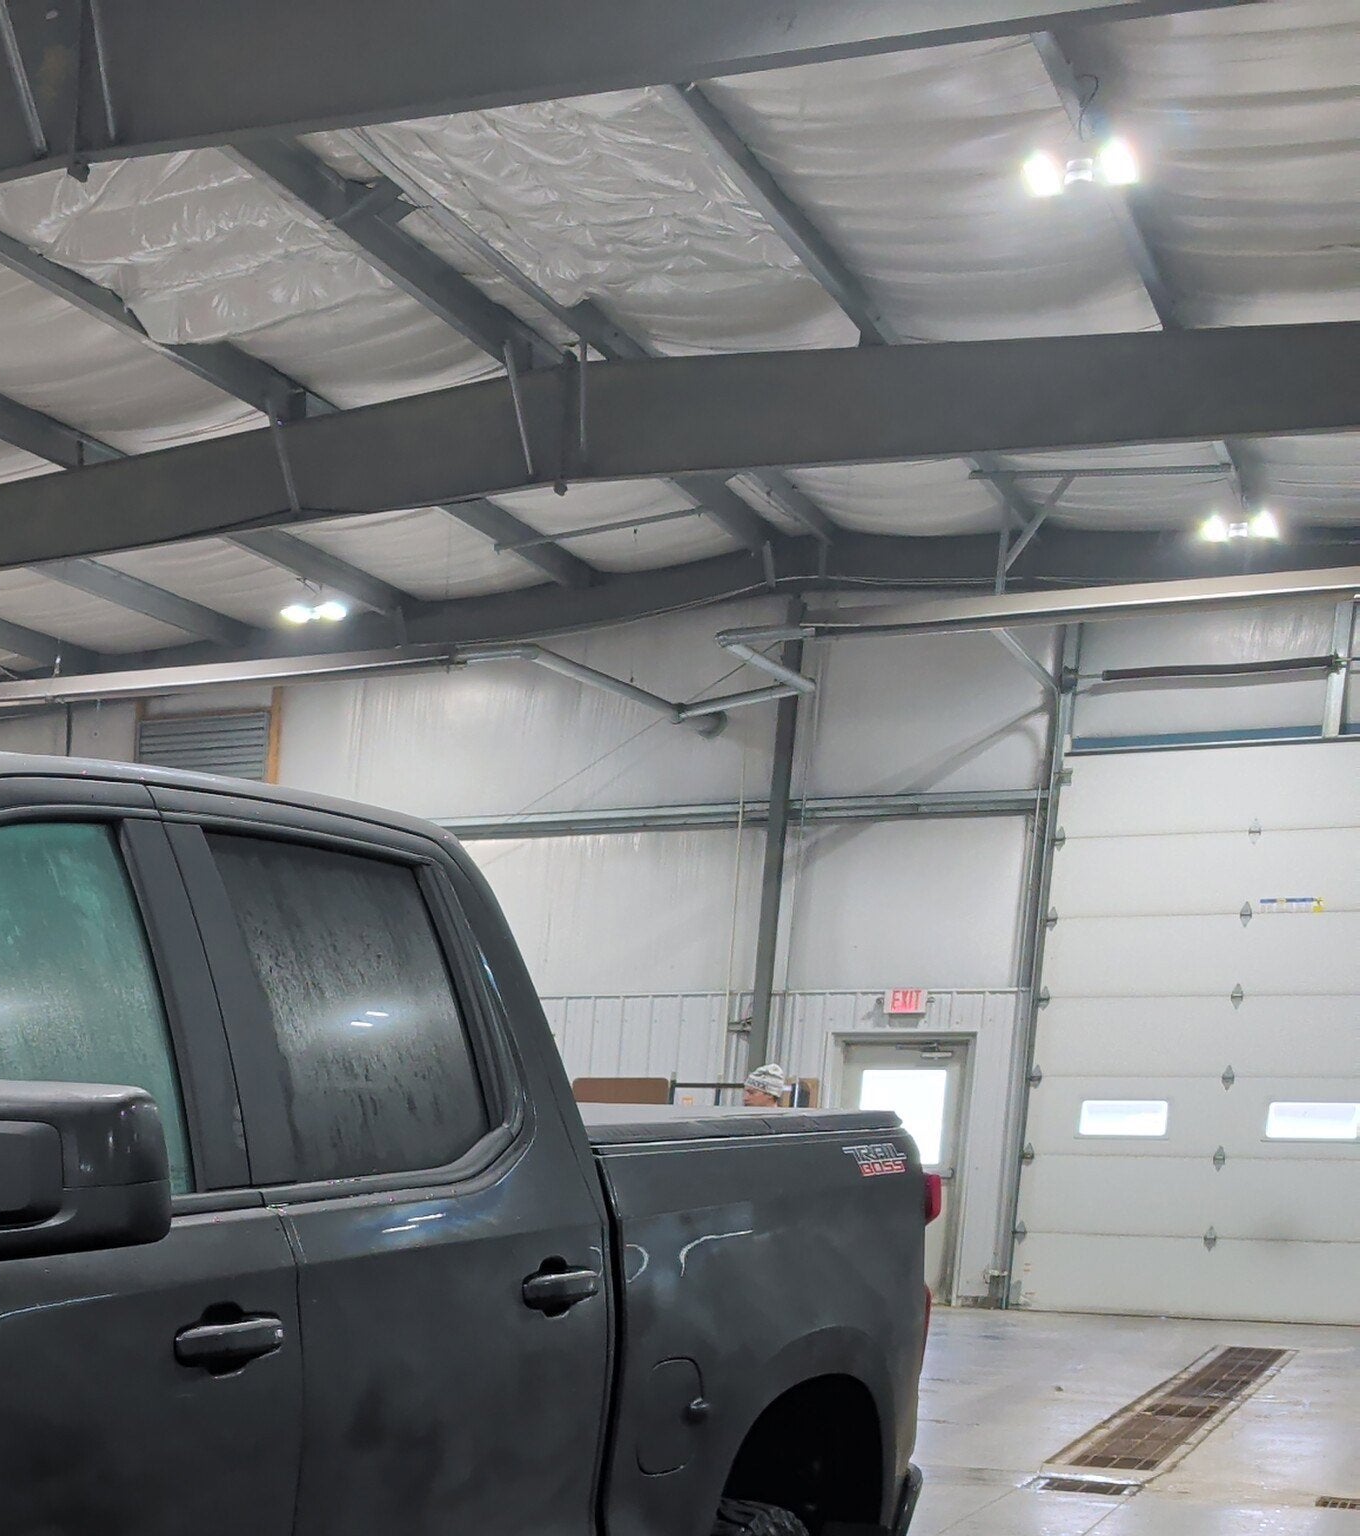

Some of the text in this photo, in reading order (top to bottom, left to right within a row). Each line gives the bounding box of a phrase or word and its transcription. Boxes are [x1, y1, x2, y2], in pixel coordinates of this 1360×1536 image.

[892, 990, 922, 1010] EXIT
[842, 1143, 907, 1164] TRAIL
[859, 1160, 906, 1176] BOSS
